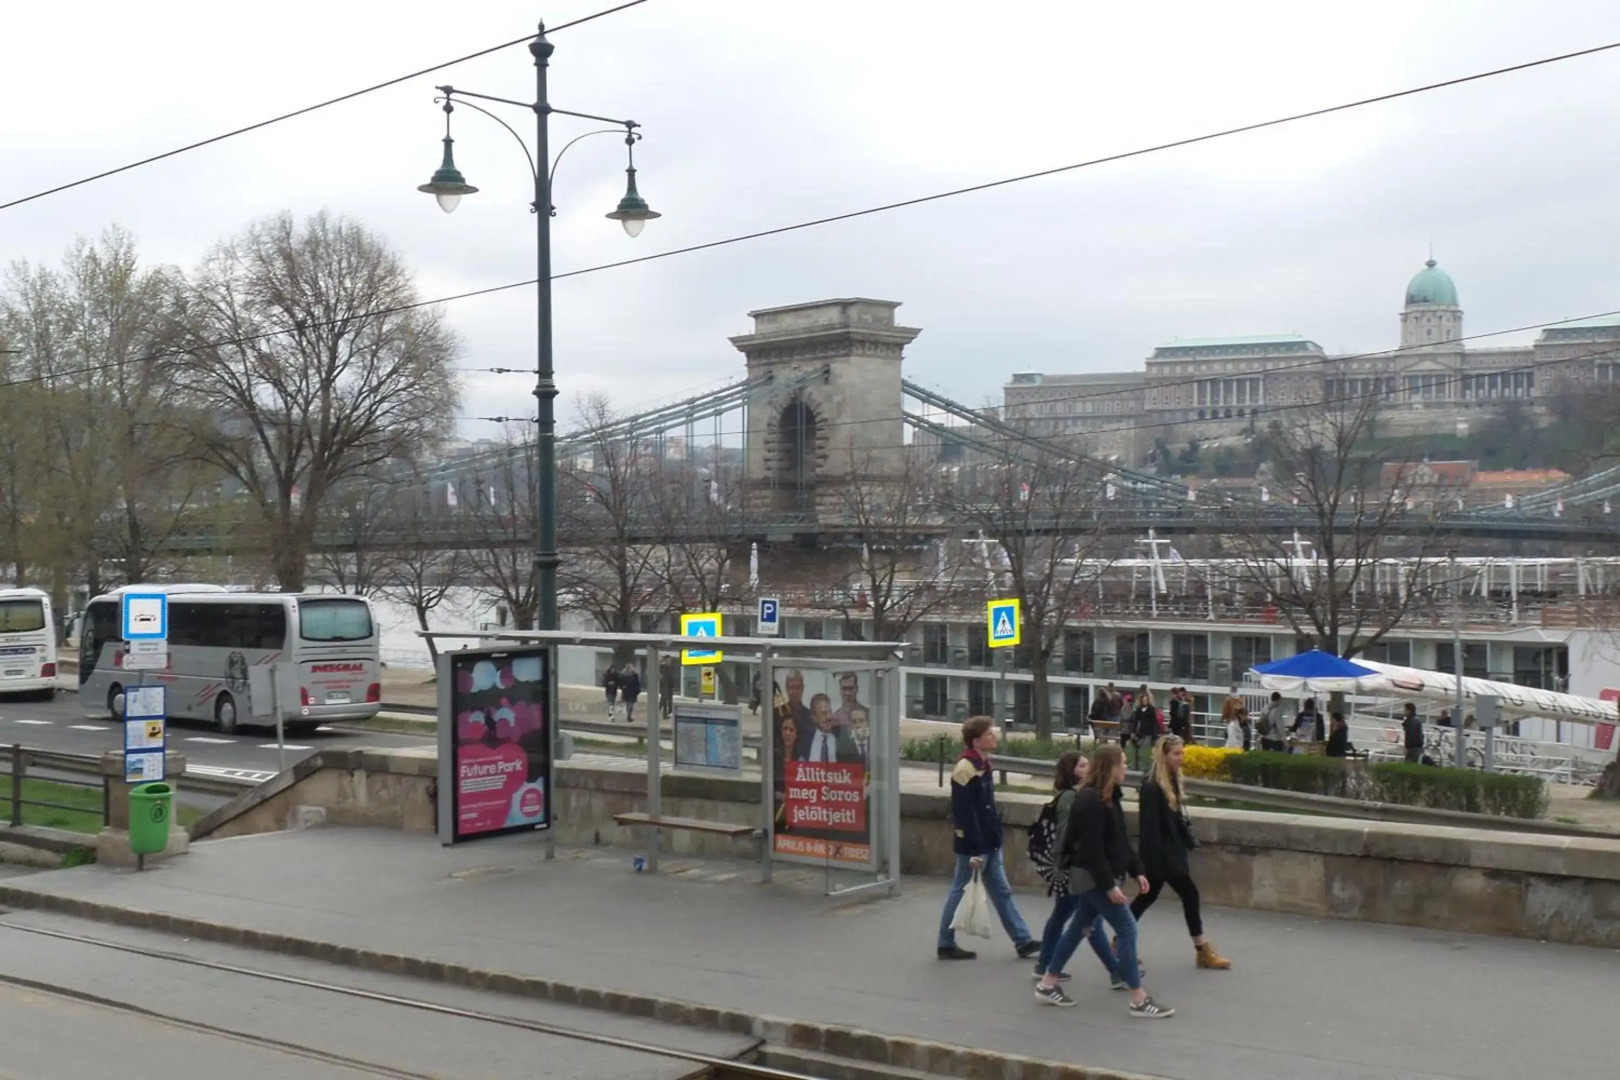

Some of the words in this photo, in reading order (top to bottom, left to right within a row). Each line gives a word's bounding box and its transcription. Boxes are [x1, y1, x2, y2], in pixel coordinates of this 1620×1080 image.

[763, 603, 774, 619] P
[310, 663, 365, 673] INTEGRAL
[1529, 688, 1619, 722] CRUISE
[460, 764, 497, 777] Future
[497, 759, 523, 773] Park
[795, 763, 852, 784] Állítsuk
[789, 787, 818, 803] meg
[821, 786, 860, 802] Soros
[792, 805, 856, 825] jelöltjeit!
